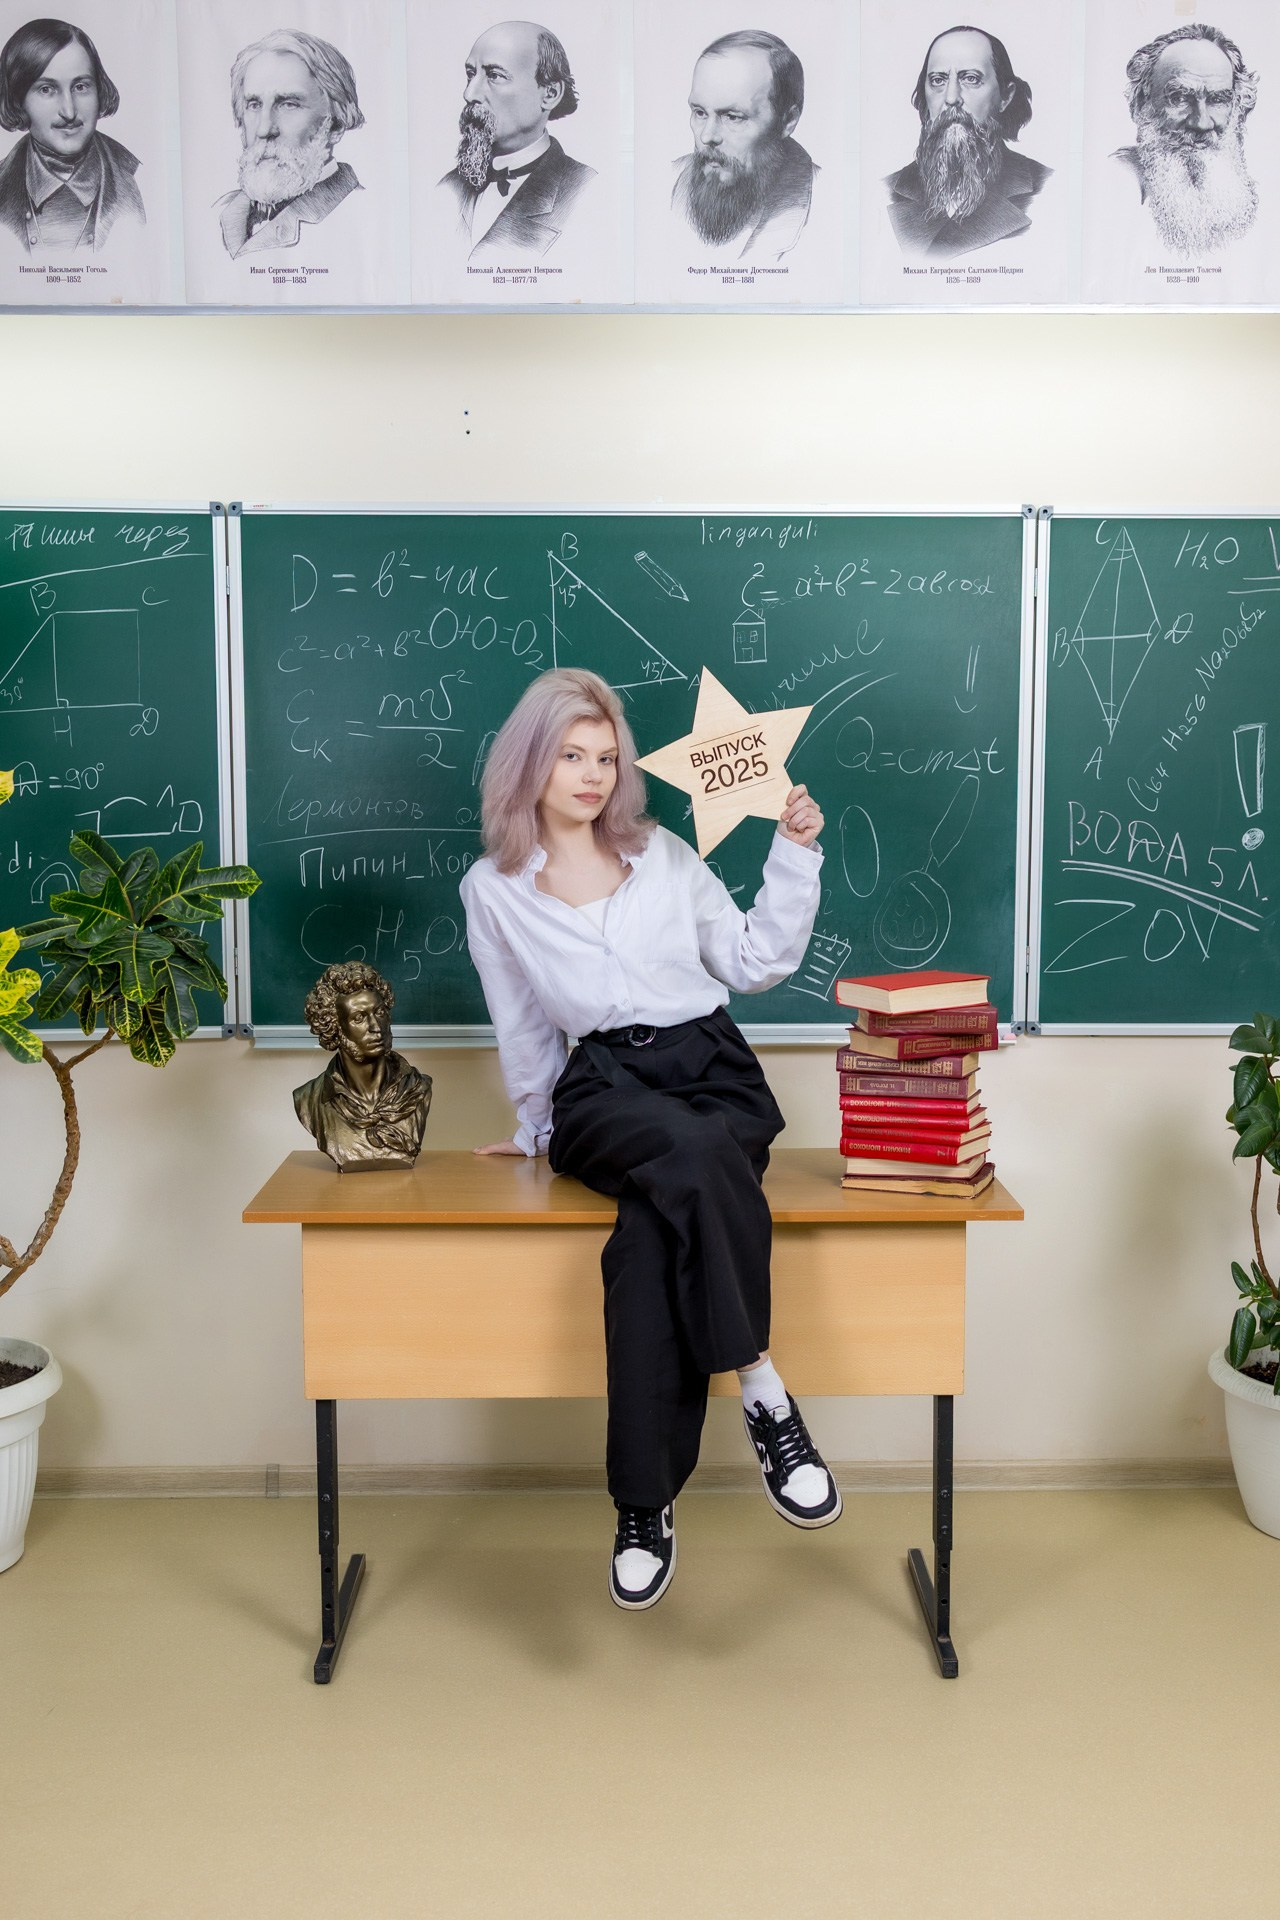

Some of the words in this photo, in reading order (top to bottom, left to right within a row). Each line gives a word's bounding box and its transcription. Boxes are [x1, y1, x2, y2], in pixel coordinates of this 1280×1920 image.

[19, 265, 46, 274] Николай
[49, 265, 83, 274] Васильевич
[86, 265, 107, 274] Гоголь
[250, 266, 265, 276] Иван
[268, 266, 298, 276] Сергеевич
[301, 266, 328, 276] Тургенев
[467, 265, 493, 275] Николай
[496, 265, 531, 275] Алексеевич
[534, 265, 562, 275] Некрасов
[688, 265, 707, 276] Федор
[710, 265, 748, 276] Михайлович
[751, 265, 788, 276] Достоевский
[903, 265, 927, 276] Михаил
[930, 265, 965, 276] Евграфович
[968, 265, 1023, 276] Салтыков-Щедрин
[1144, 265, 1156, 275] Лев
[1159, 265, 1194, 275] Николаевич
[1197, 265, 1221, 275] Толстой
[690, 732, 767, 768] ВЫПУСК
[701, 752, 769, 794] 2025
